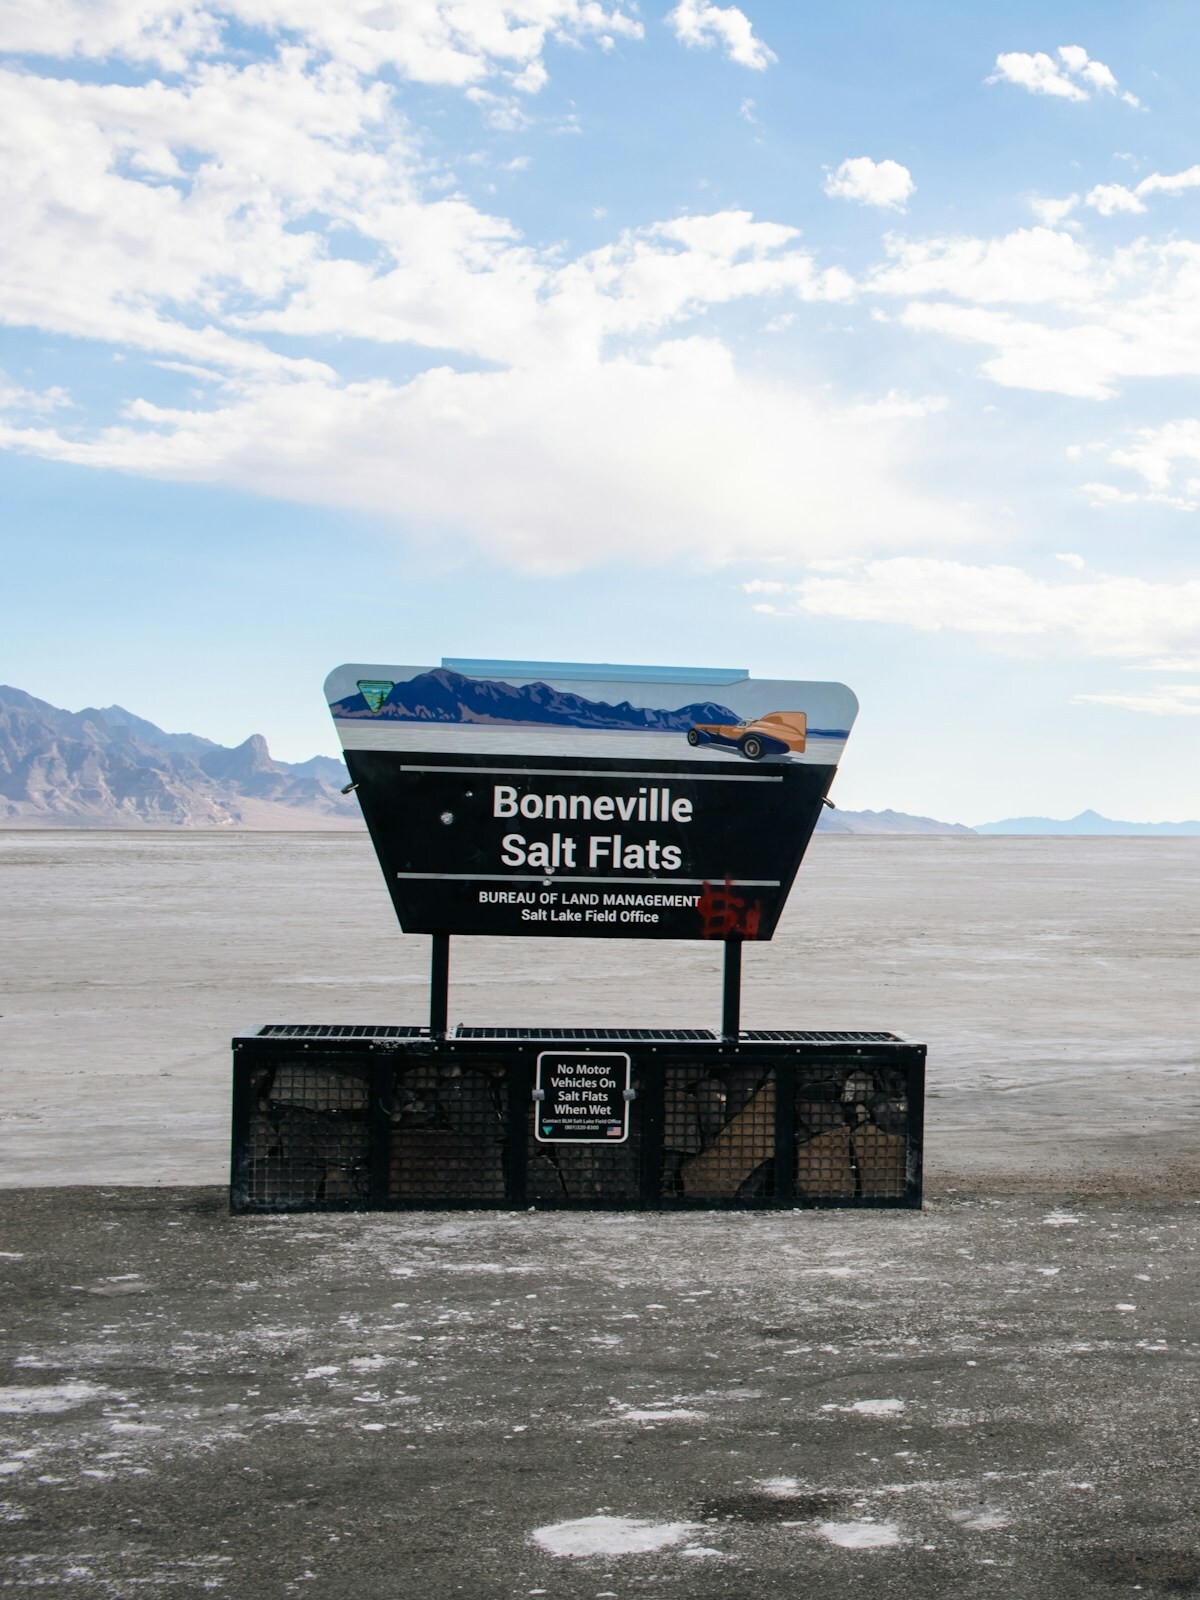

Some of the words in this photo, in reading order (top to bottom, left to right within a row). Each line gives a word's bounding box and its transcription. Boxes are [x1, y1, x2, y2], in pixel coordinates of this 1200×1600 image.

[493, 785, 693, 823] Bonneville
[501, 832, 577, 869] Salt
[589, 834, 682, 870] Flats
[479, 891, 536, 904] BUREAU
[539, 892, 559, 905] OF
[561, 893, 599, 906] LAND
[603, 893, 701, 908] MANAGEMENT
[521, 908, 548, 921] Salt
[550, 909, 582, 922] Lake
[585, 909, 617, 922] Field
[620, 910, 659, 923] Office
[557, 1064, 574, 1074] No
[576, 1064, 611, 1075] Motor
[550, 1077, 597, 1088] Vehicles
[599, 1077, 616, 1088] On
[558, 1090, 580, 1101] Salt
[582, 1091, 608, 1101] Flats
[554, 1104, 587, 1114] When
[589, 1105, 612, 1115] Wet
